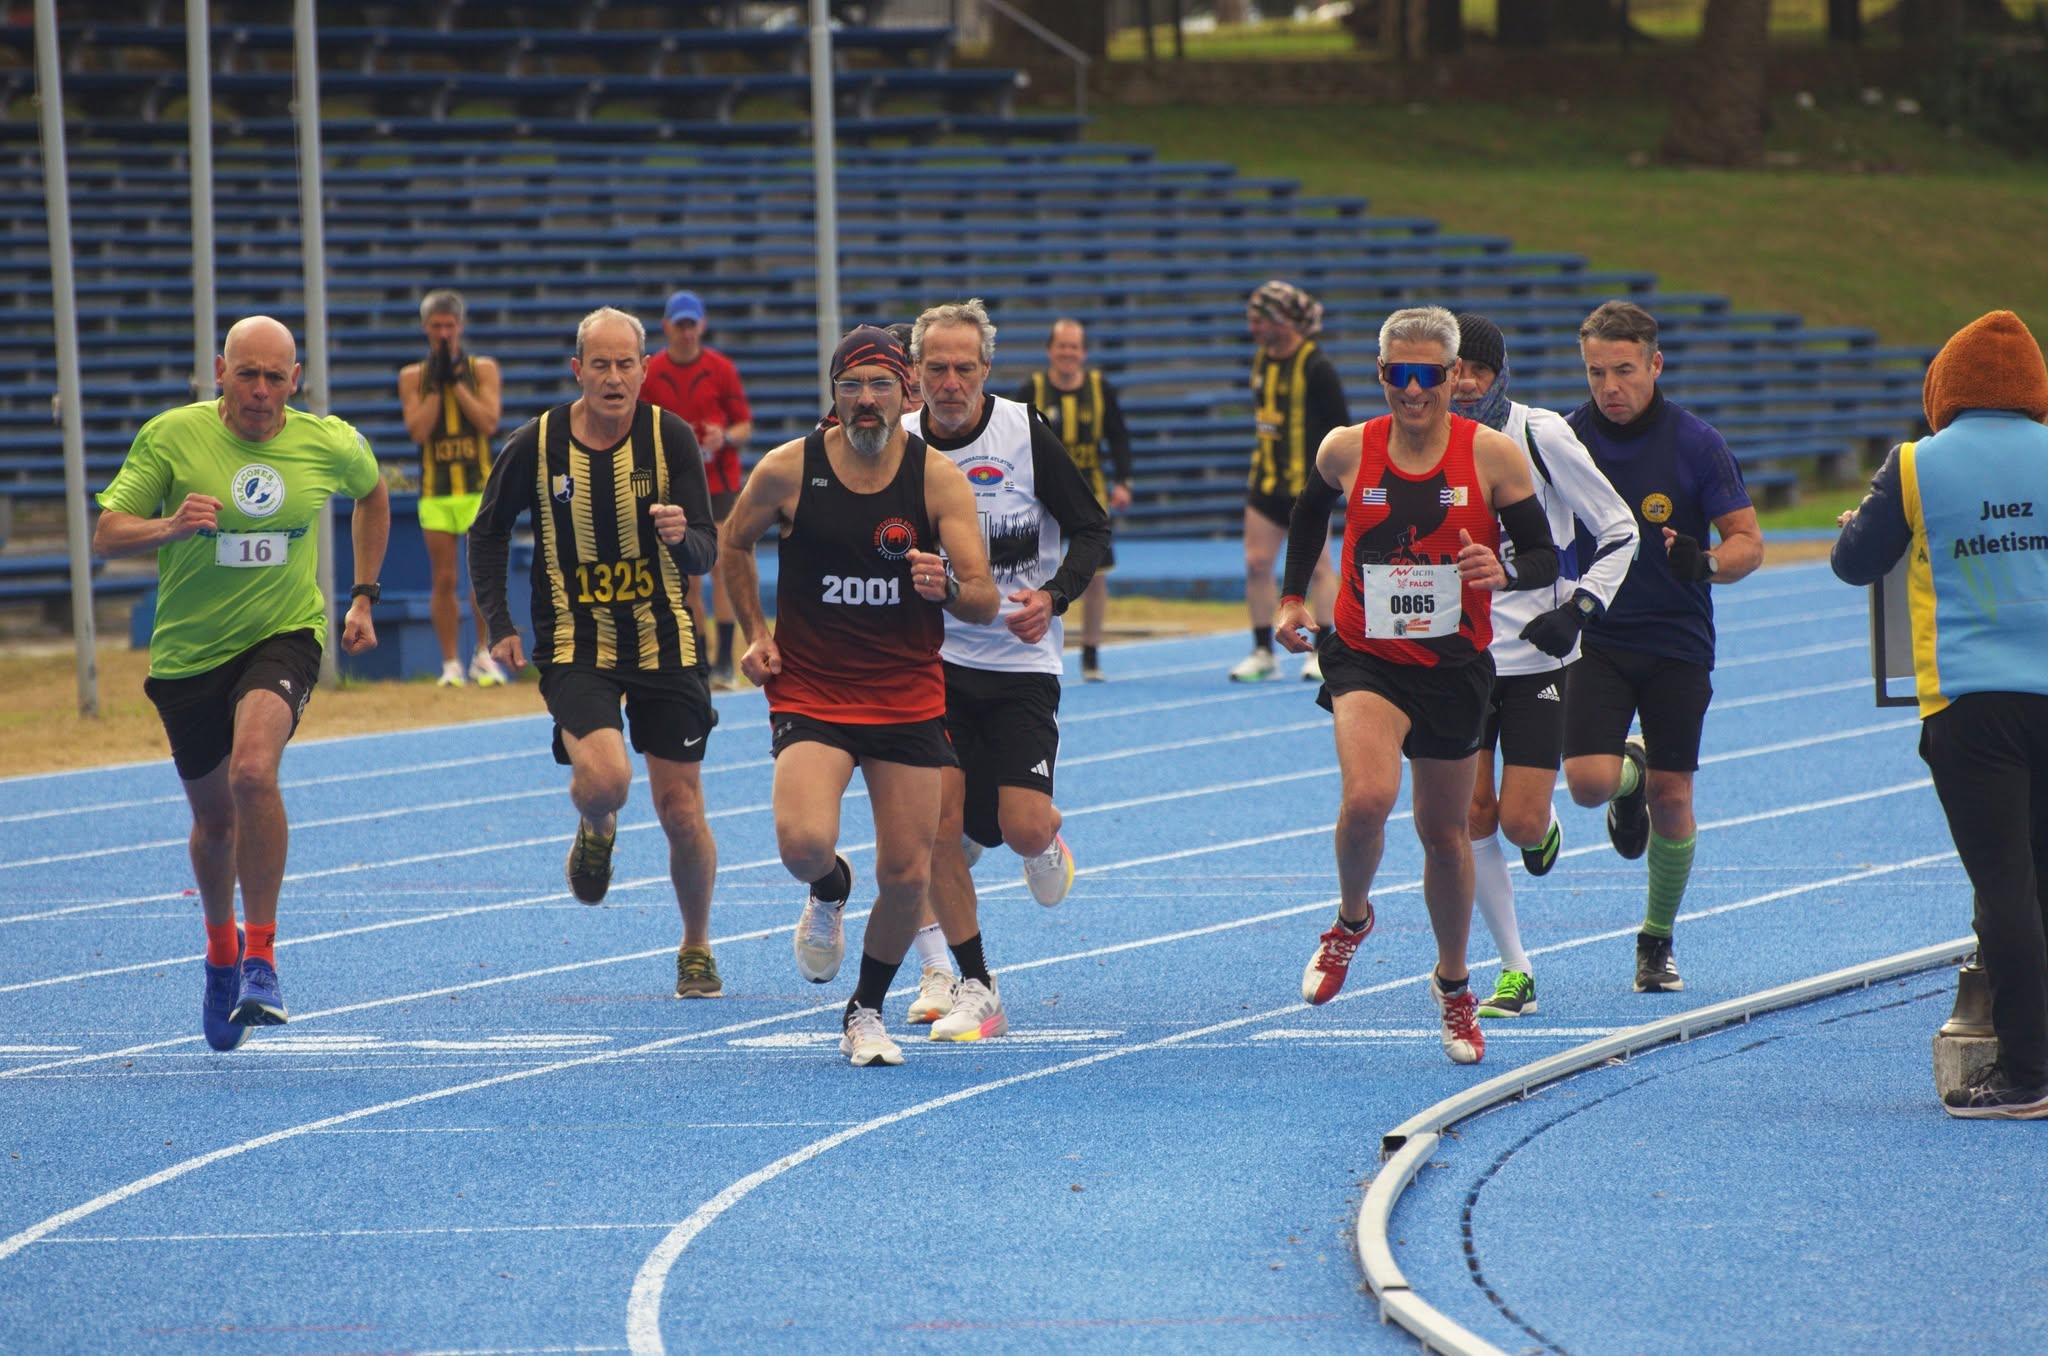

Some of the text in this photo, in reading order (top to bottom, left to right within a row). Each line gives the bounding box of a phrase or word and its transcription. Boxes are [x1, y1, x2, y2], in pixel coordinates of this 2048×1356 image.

[1980, 501, 2033, 521] Juez
[240, 539, 272, 562] 16
[575, 558, 655, 603] 1325
[822, 575, 901, 606] 2001
[1409, 580, 1434, 588] FALCK
[1390, 594, 1435, 615] 0865
